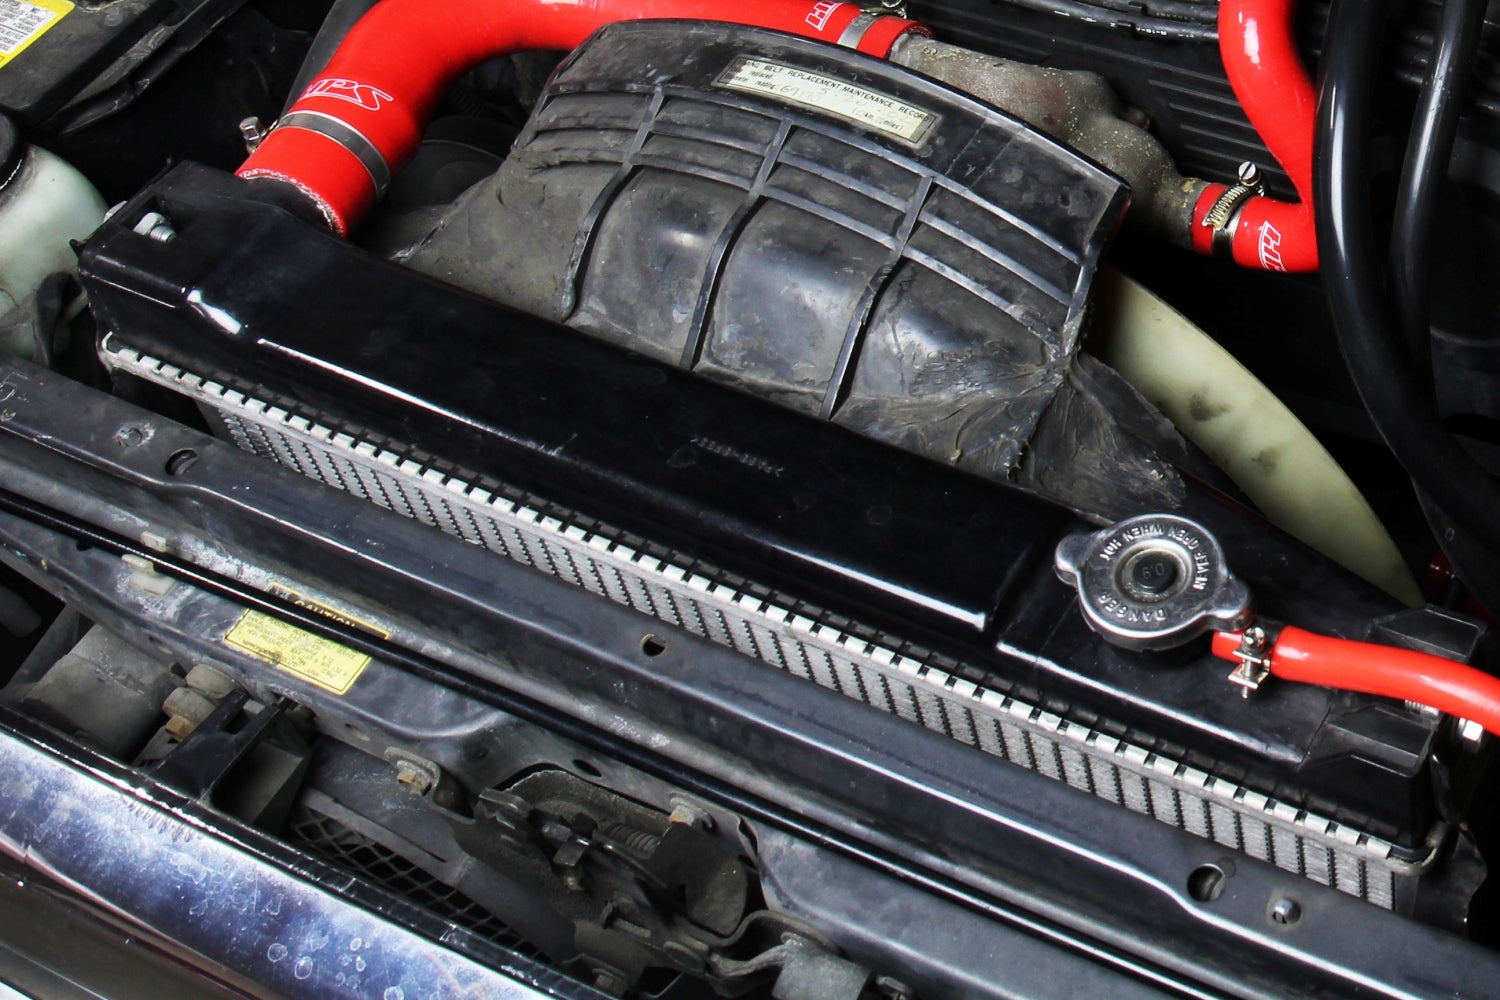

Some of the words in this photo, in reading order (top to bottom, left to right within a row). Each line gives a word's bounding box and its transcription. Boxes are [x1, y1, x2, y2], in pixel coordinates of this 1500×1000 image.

[764, 64, 783, 74] BELT
[787, 70, 841, 90] REPLACEMENT
[842, 86, 894, 109] MAINTENANCE
[899, 106, 930, 122] RECORD
[1122, 524, 1164, 542] WHEN
[1168, 527, 1200, 550] OPEN
[1099, 537, 1123, 562] HOT
[1098, 592, 1167, 623] DANGER
